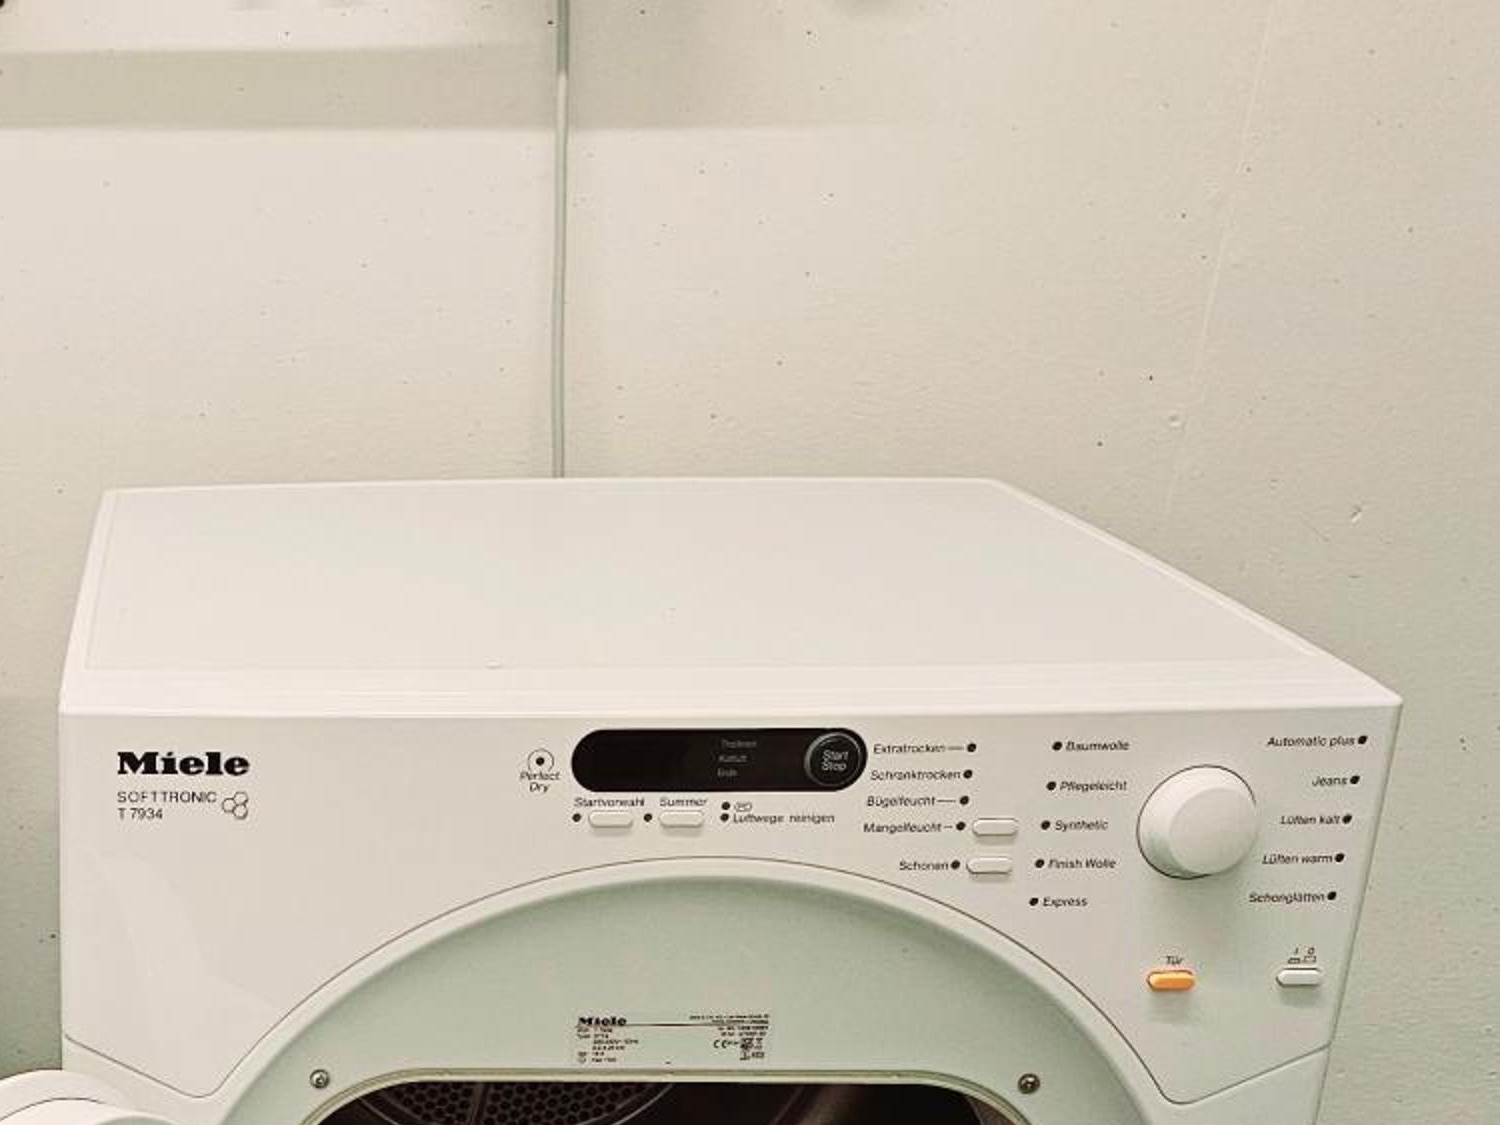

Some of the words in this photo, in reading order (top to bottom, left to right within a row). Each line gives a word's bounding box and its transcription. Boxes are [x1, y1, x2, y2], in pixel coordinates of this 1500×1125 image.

[1065, 741, 1130, 751] Baumwolle
[1267, 736, 1327, 747] Automatic
[1329, 736, 1355, 748] plus
[874, 744, 946, 754] Extratrocken
[822, 750, 849, 762] Start
[117, 751, 250, 776] Miele
[821, 760, 847, 772] Stop
[519, 770, 560, 782] Perfect
[870, 769, 961, 780] Schranktrocken
[1059, 780, 1128, 793] Pflegeleicht
[1311, 776, 1347, 787] Jeans
[529, 782, 550, 794] Dry
[117, 791, 218, 803] SOFTTRONIC
[573, 797, 645, 807] Startvorwahl
[659, 797, 708, 807] Summer
[867, 796, 936, 808] Bügelfeucht
[118, 808, 127, 820] T
[130, 808, 163, 820] 7934
[733, 813, 784, 825] Luftwege
[789, 813, 835, 825] reinigen
[1280, 814, 1317, 826] Lüften
[1318, 814, 1341, 825] kalt
[863, 822, 943, 834] Mangelfeucht
[1054, 819, 1109, 833] Synthetic
[899, 859, 949, 871] Schonen
[1048, 858, 1083, 869] Finish
[1085, 858, 1117, 869] Wolle
[1262, 853, 1298, 865] Lüften
[1301, 854, 1333, 864] warm
[1042, 896, 1088, 908] Express
[1249, 891, 1325, 904] Schonglätten
[578, 1016, 627, 1027] Miele
